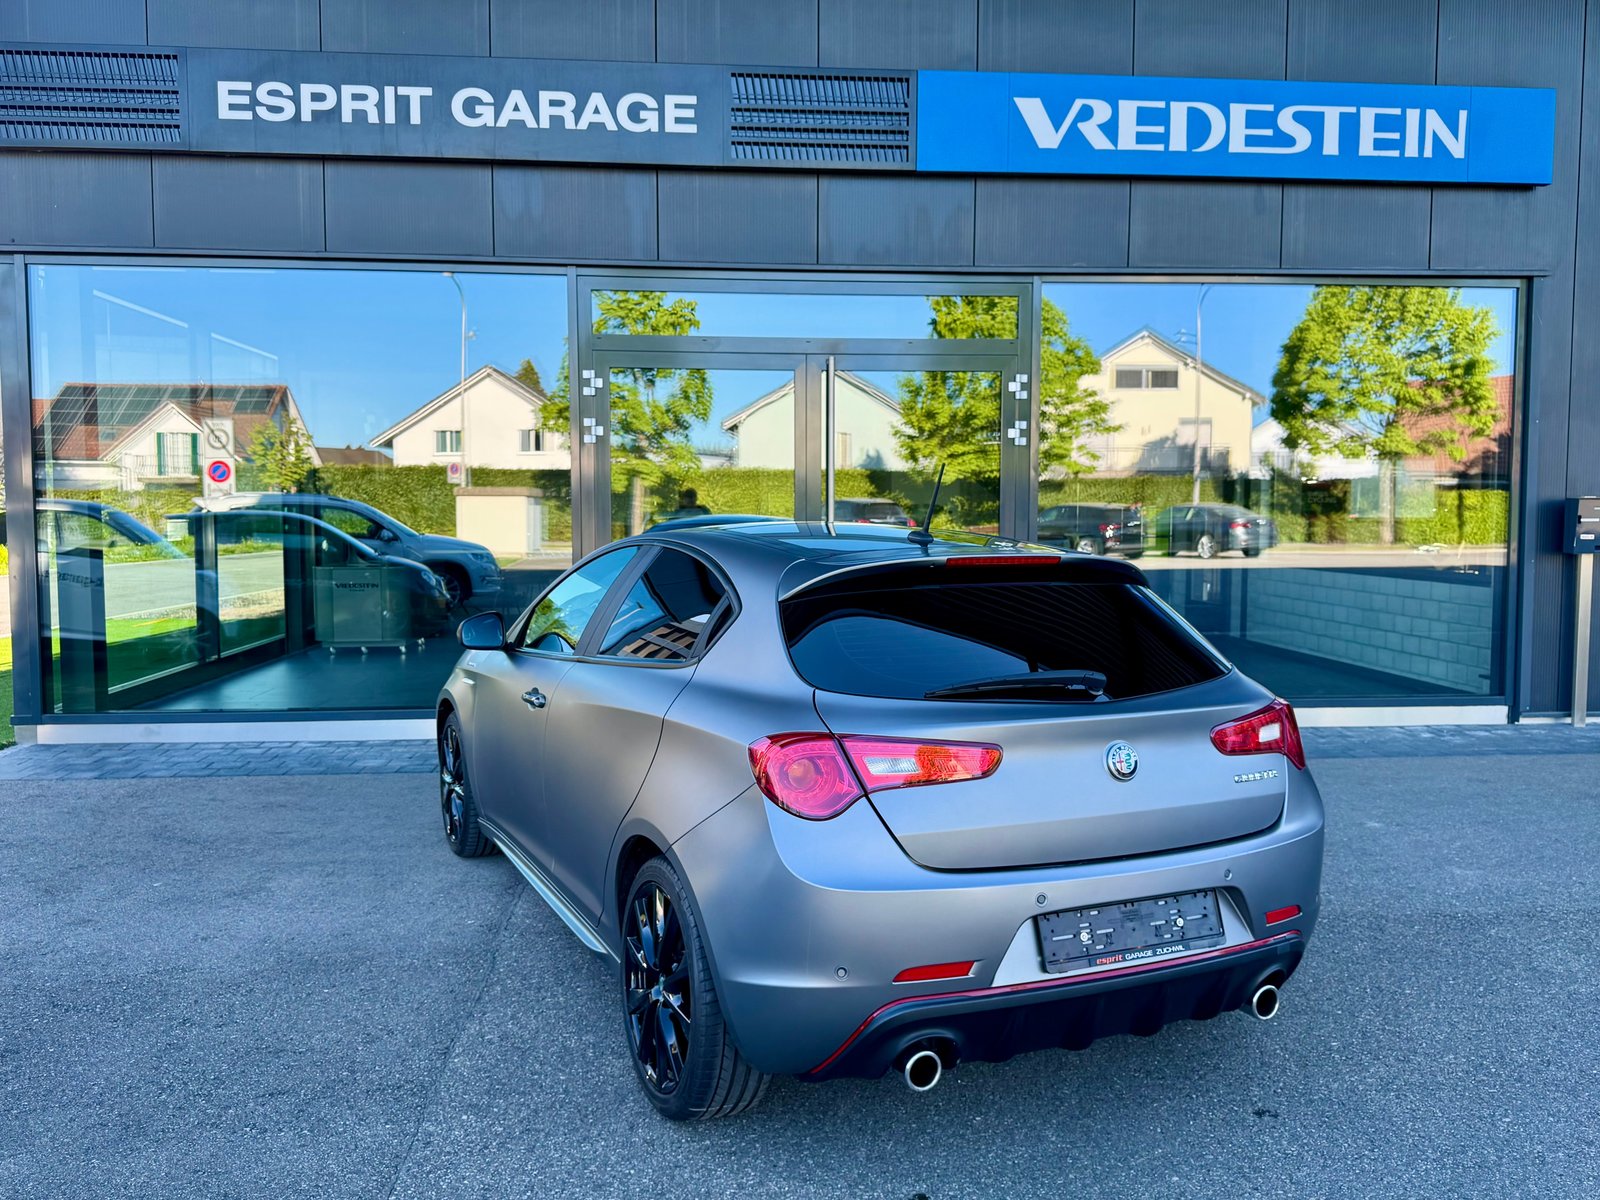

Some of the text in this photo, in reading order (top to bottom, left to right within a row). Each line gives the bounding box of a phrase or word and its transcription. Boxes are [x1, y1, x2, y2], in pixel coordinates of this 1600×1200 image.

[217, 80, 698, 134] ESPRIT GARAGE
[1013, 96, 1468, 160] VREDESTEIN
[1096, 953, 1123, 965] esprit
[1125, 950, 1153, 961] GARAGE
